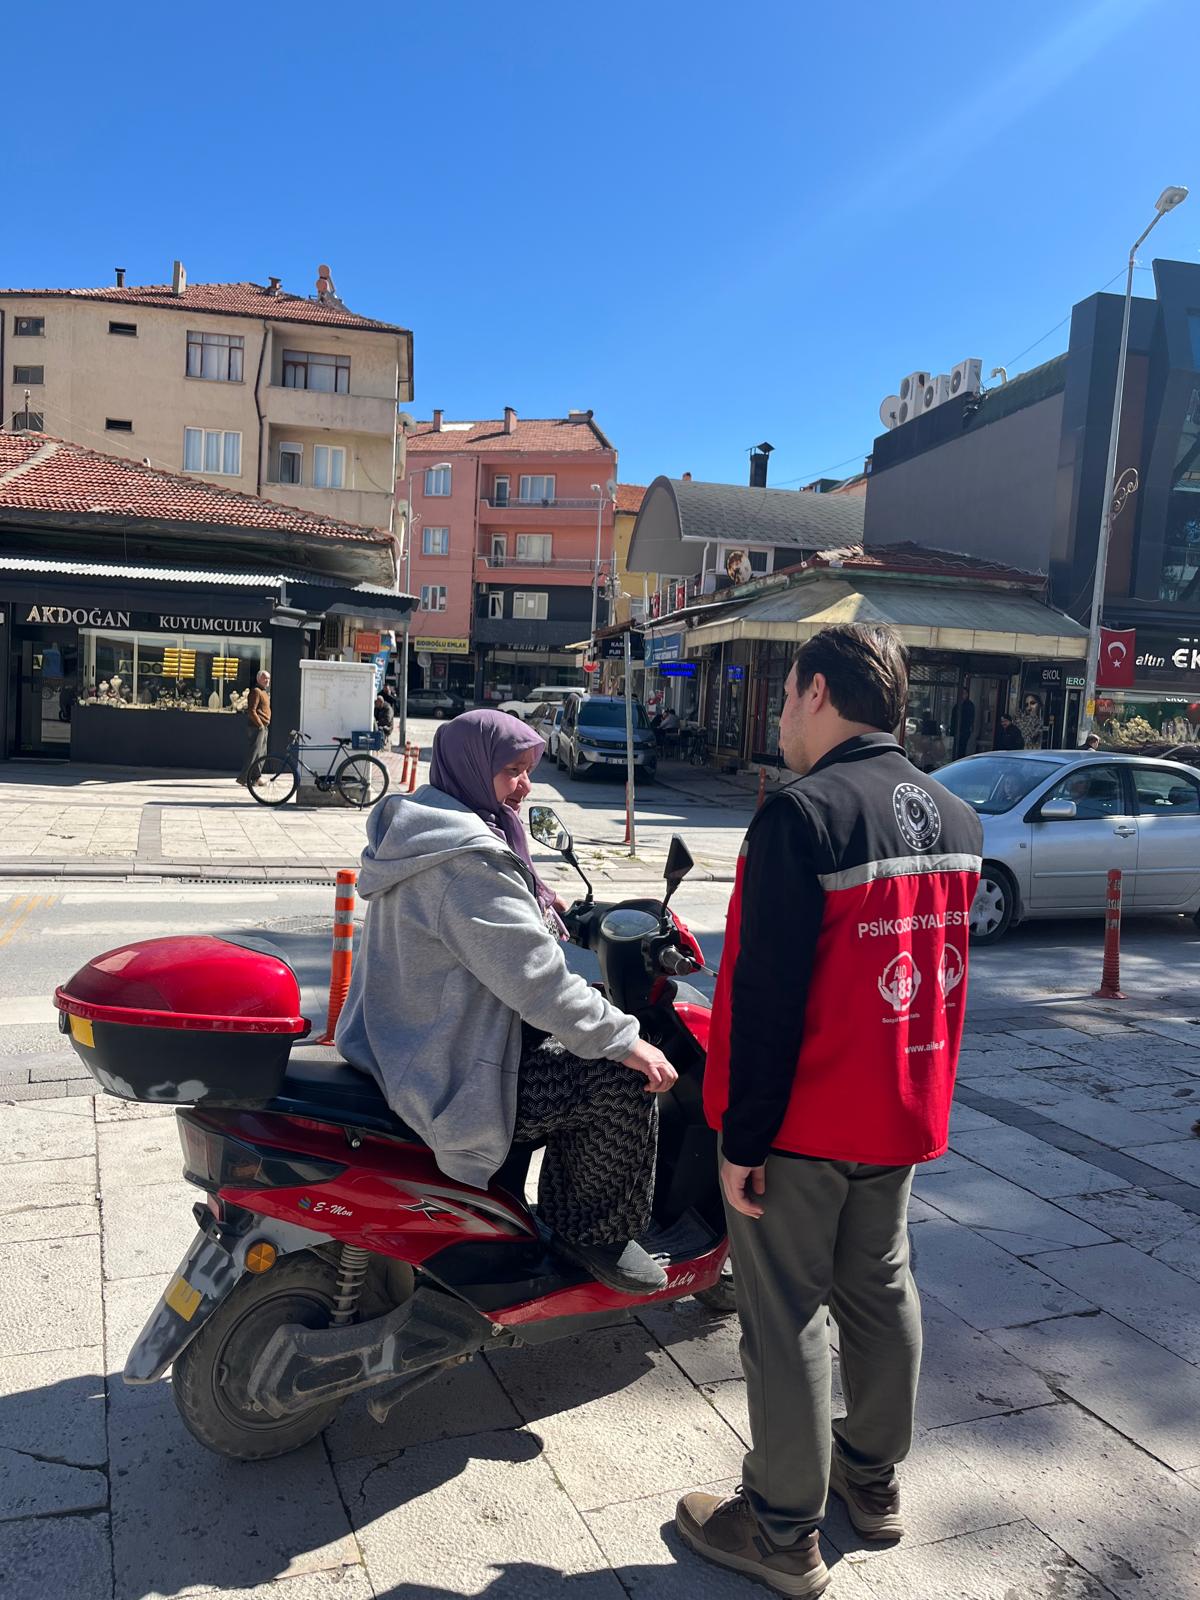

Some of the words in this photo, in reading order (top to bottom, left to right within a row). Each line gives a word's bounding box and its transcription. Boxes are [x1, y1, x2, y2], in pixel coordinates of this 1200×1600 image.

[26, 605, 131, 627] AKDOĞAN
[159, 616, 262, 633] KUYUMCULUK
[1135, 653, 1165, 667] altın
[1042, 669, 1060, 680] EKOL
[893, 965, 907, 979] ALO
[889, 976, 913, 999] 183
[313, 1202, 353, 1217] E-Mon
